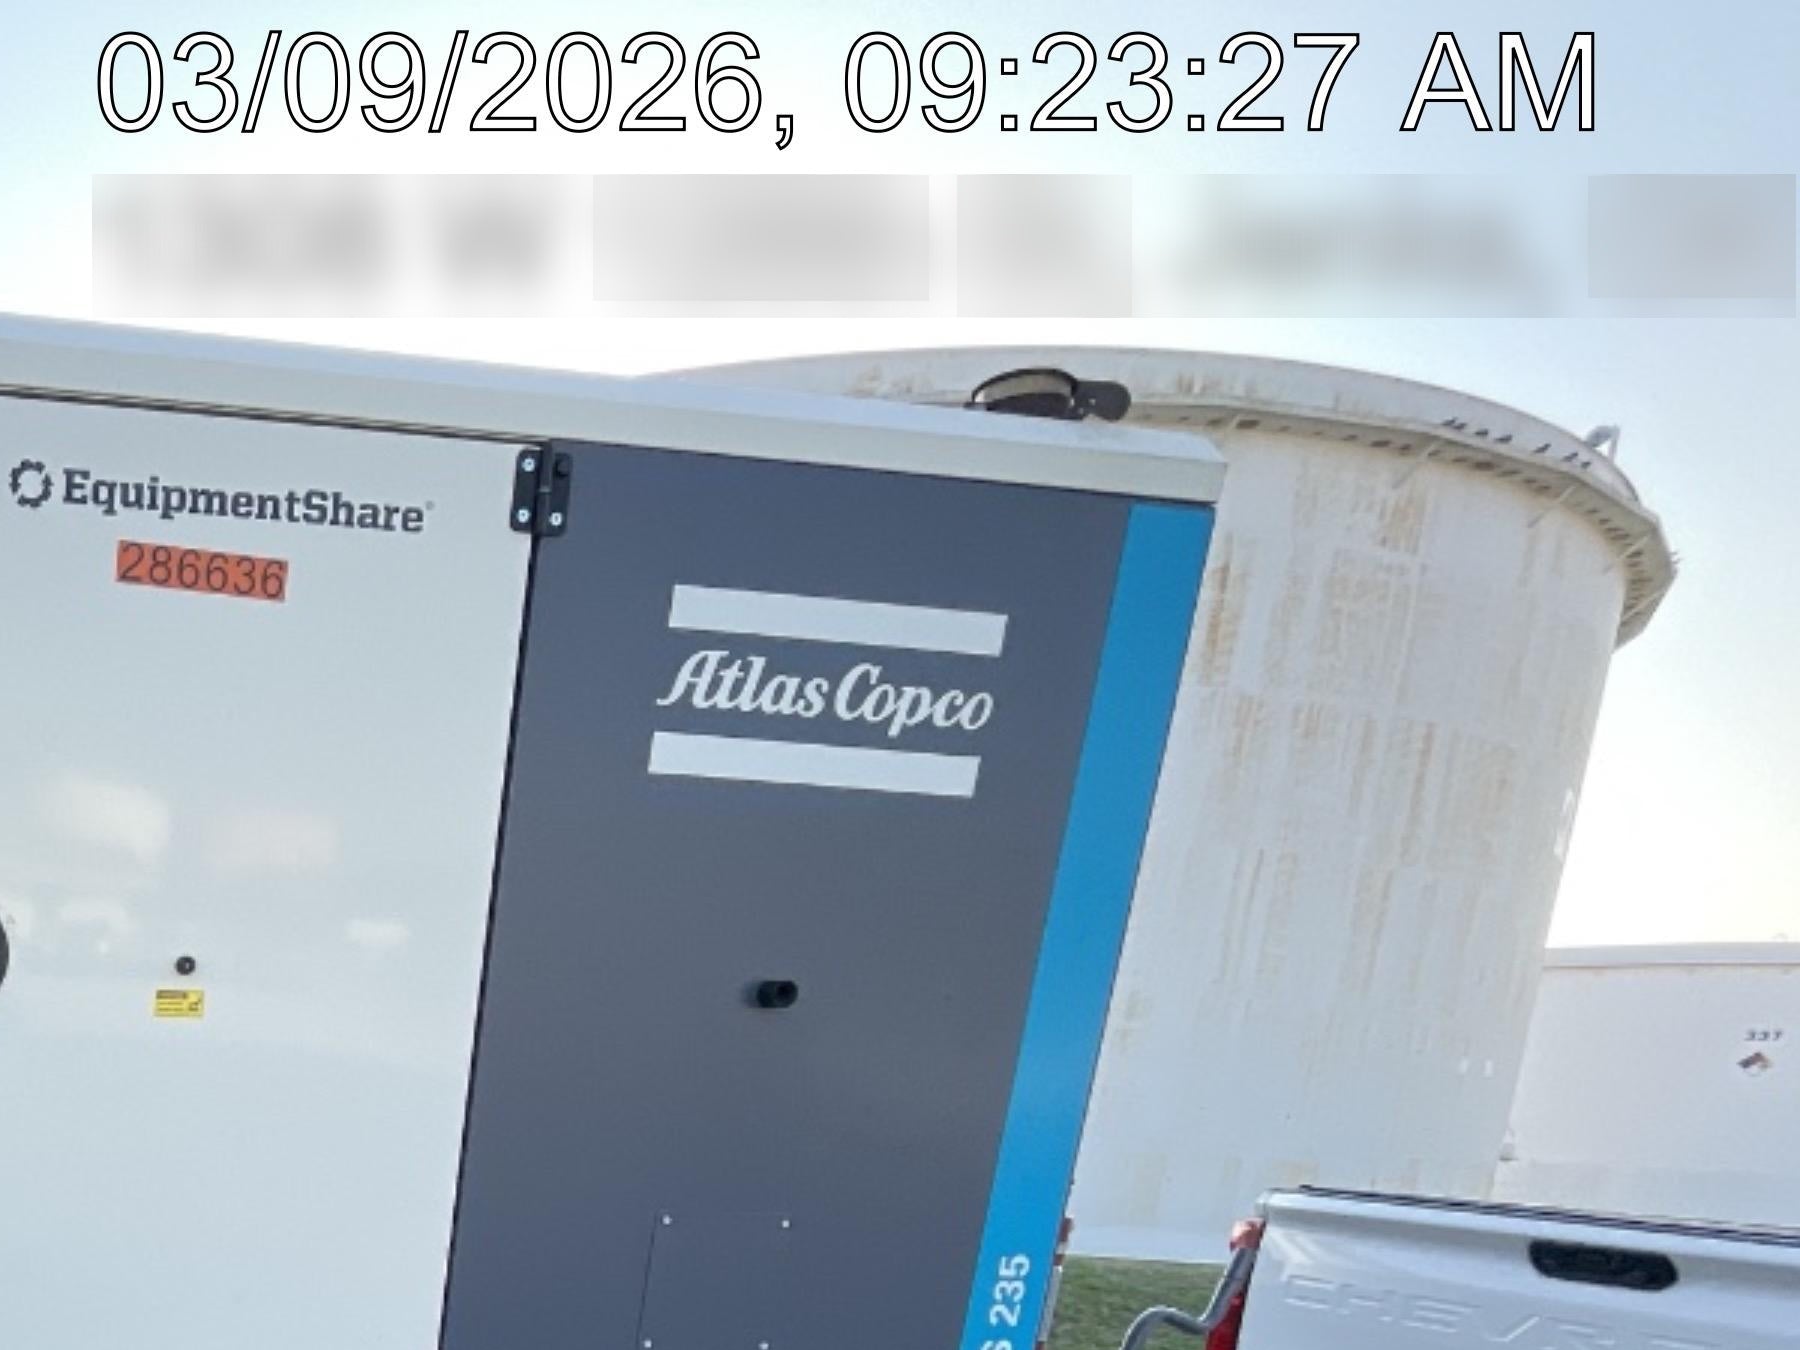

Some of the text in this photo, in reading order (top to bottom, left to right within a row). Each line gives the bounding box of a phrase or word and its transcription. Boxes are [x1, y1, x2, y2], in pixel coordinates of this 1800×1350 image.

[61, 466, 426, 534] EquipmentShare
[117, 541, 286, 600] 286636
[656, 649, 995, 739] Atlas Copco
[989, 1253, 1031, 1327] 235
